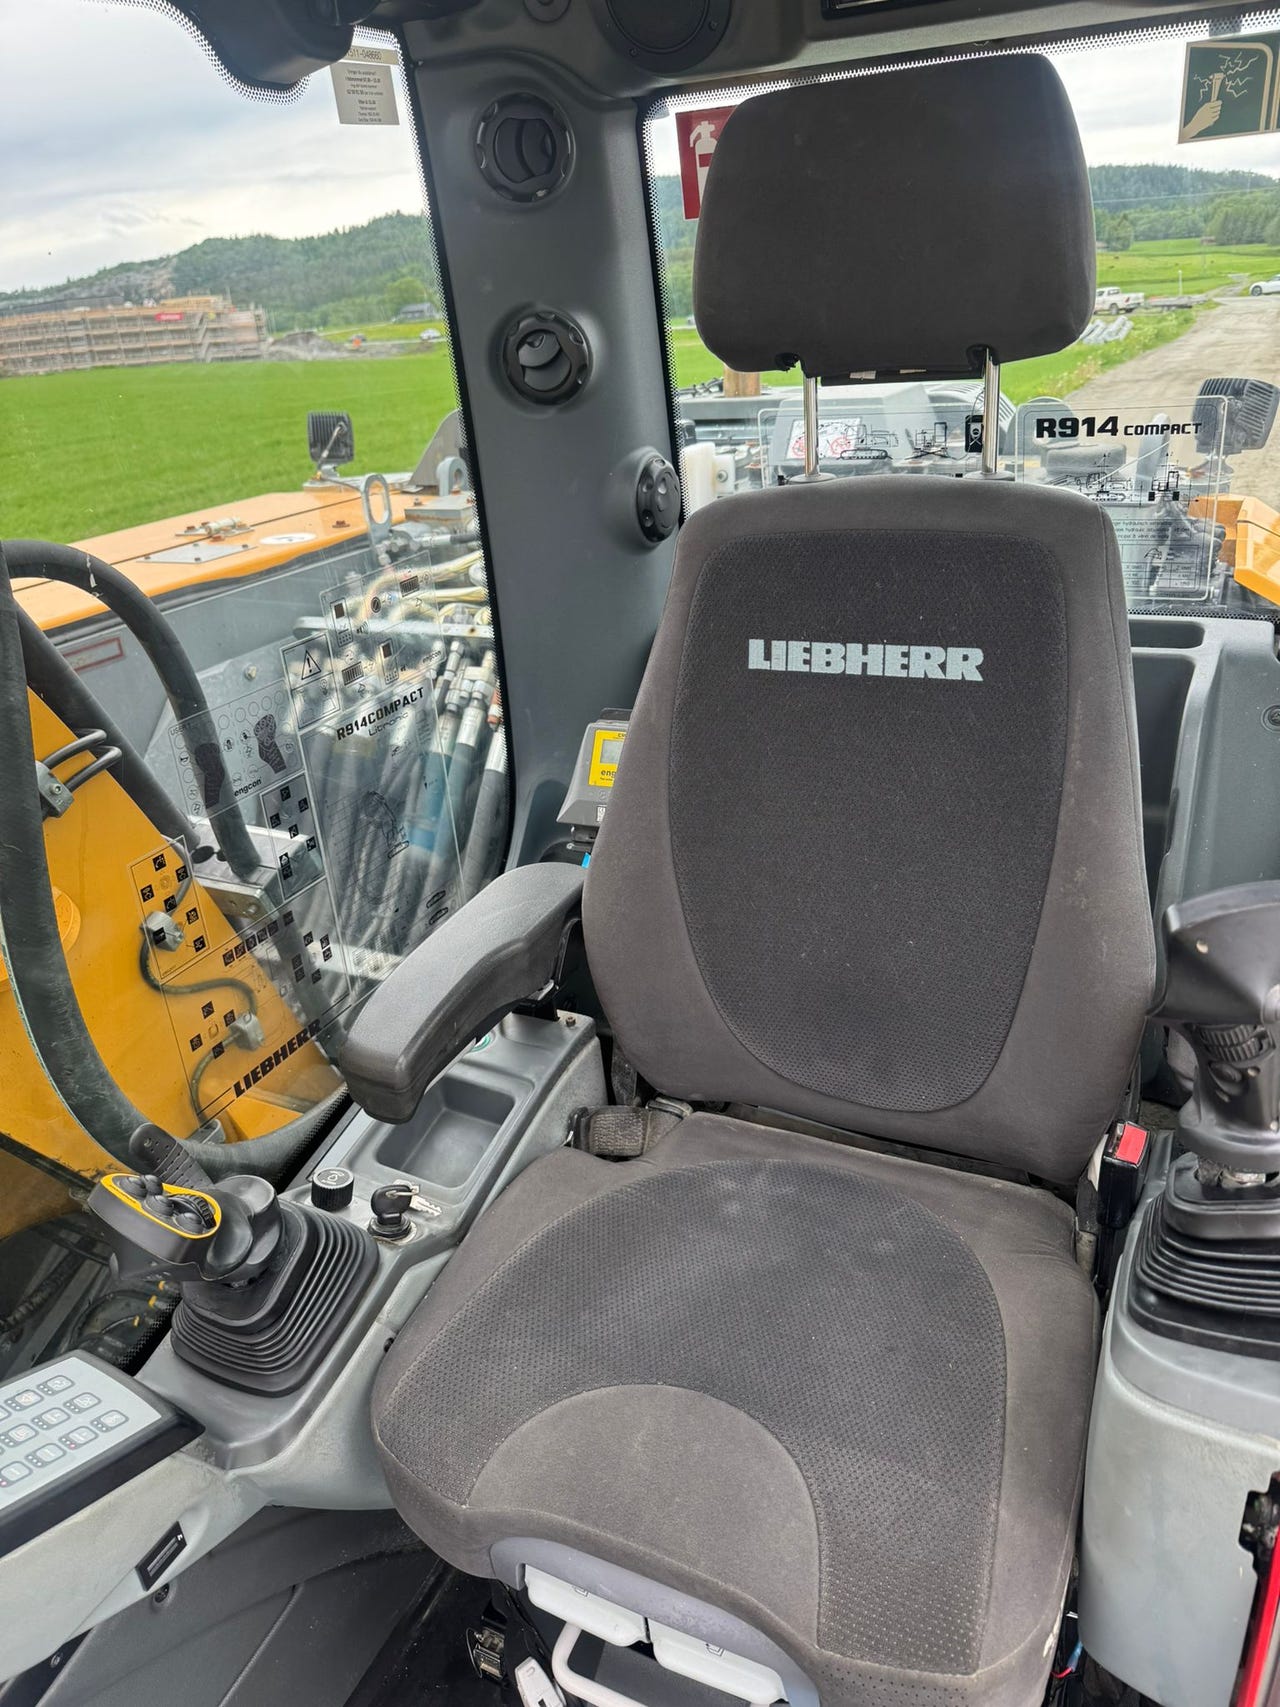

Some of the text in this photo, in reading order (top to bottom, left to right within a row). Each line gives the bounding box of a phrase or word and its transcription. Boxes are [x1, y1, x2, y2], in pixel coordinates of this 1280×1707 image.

[1036, 416, 1202, 438] R914 COMPACT
[748, 638, 984, 682] LIEBHERR
[336, 686, 425, 741] R914COMPACT
[367, 711, 409, 737] Litronic
[233, 777, 263, 798] engcon
[232, 1019, 322, 1099] LIEBHERR
